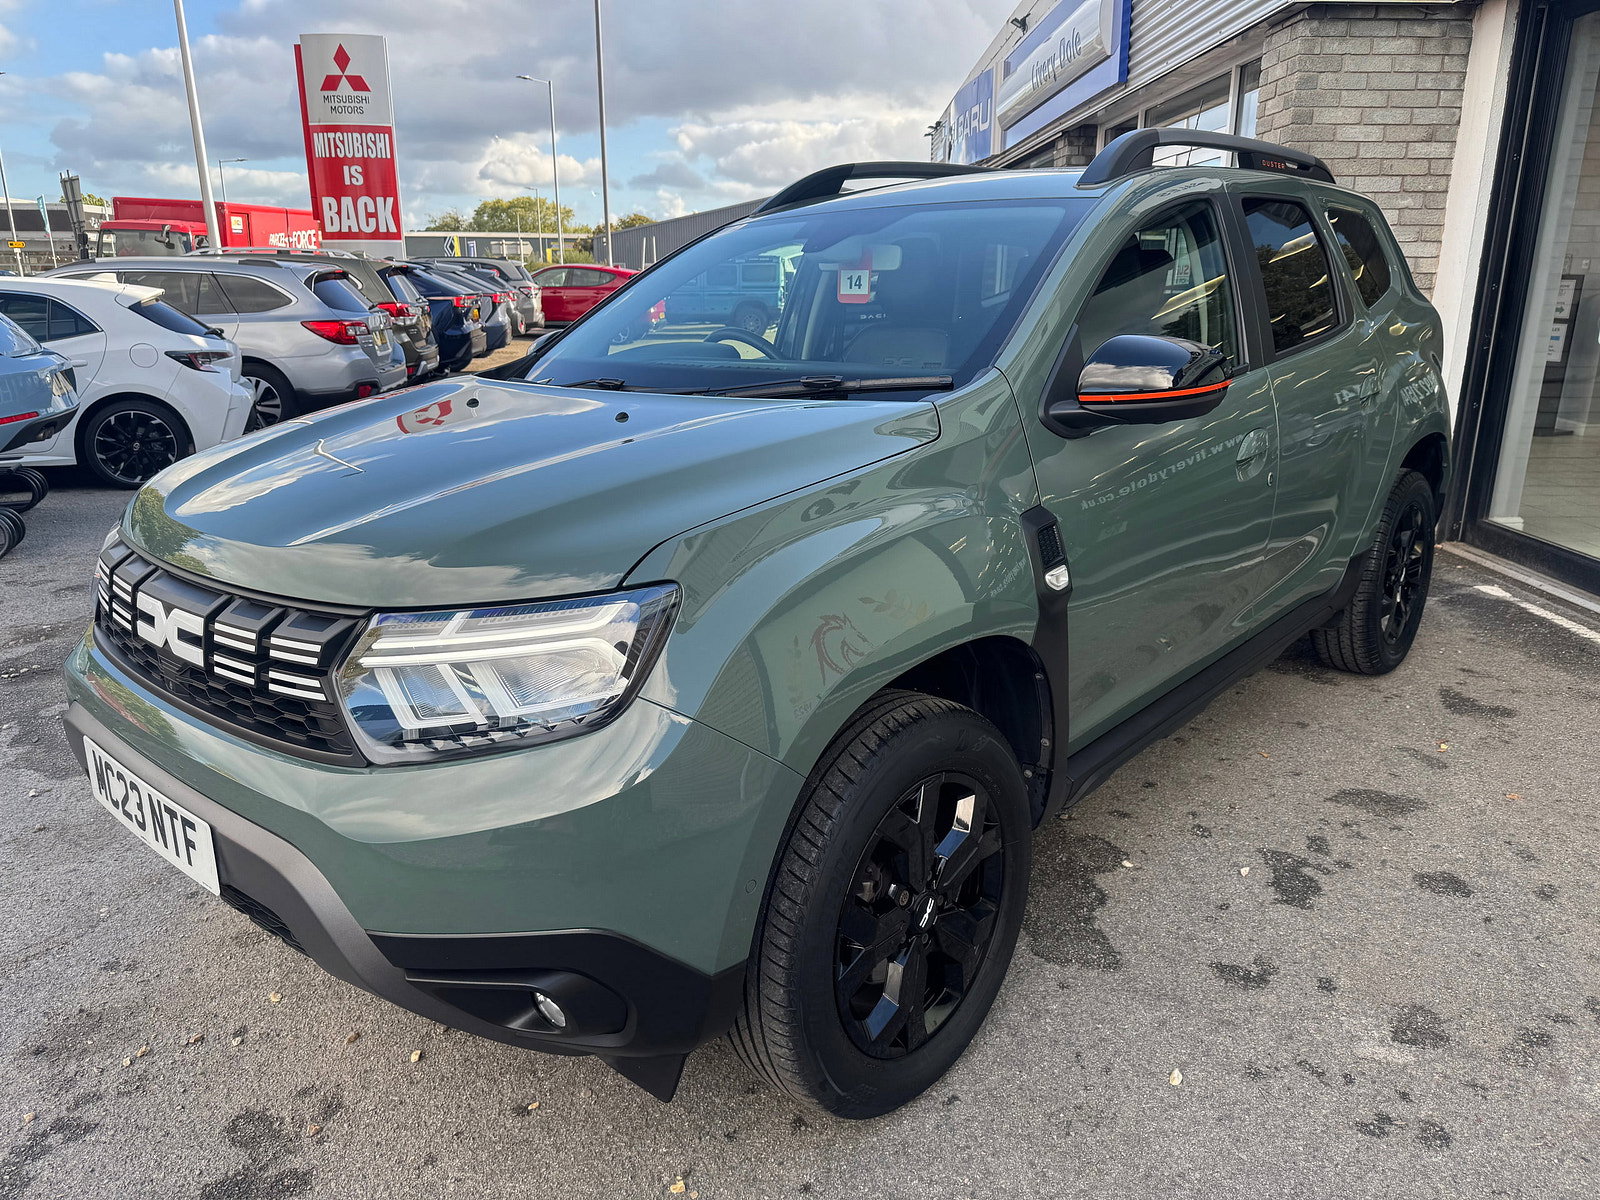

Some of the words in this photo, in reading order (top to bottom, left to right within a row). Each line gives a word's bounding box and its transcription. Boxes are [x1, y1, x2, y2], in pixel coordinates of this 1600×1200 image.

[1059, 27, 1082, 69] Dole
[323, 94, 370, 104] MITSUBISHI
[330, 105, 365, 115] MOTORS
[313, 131, 391, 159] MITSUBISHI
[343, 164, 364, 186] IS
[321, 195, 398, 233] BACK
[292, 229, 318, 250] FORCE
[847, 274, 863, 290] 14
[91, 748, 147, 832] MC23
[147, 792, 197, 867] NTF
